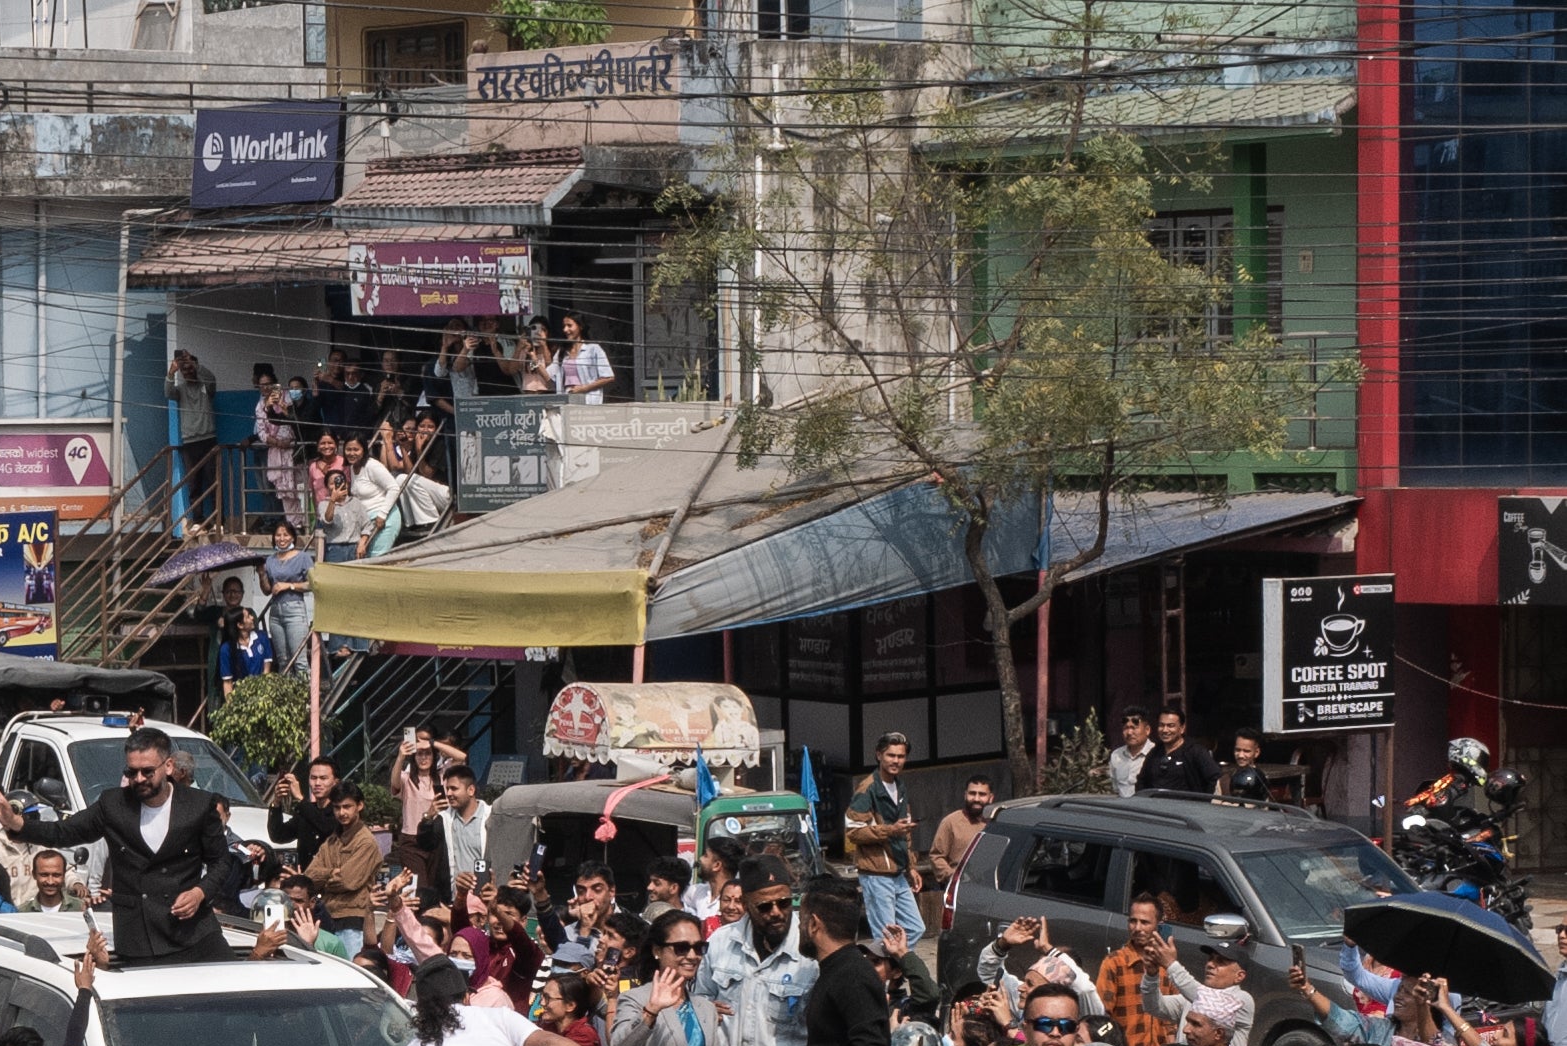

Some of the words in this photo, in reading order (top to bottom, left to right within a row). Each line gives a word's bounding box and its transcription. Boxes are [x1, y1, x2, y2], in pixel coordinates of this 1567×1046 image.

[230, 129, 328, 164] WorldLink
[27, 448, 58, 459] widest
[61, 504, 84, 512] Center
[17, 522, 49, 543] A/C
[1291, 665, 1344, 683] COFFEE
[1347, 662, 1388, 680] SPOT
[1300, 682, 1336, 694] BARISTA
[1339, 681, 1379, 692] TRAINING
